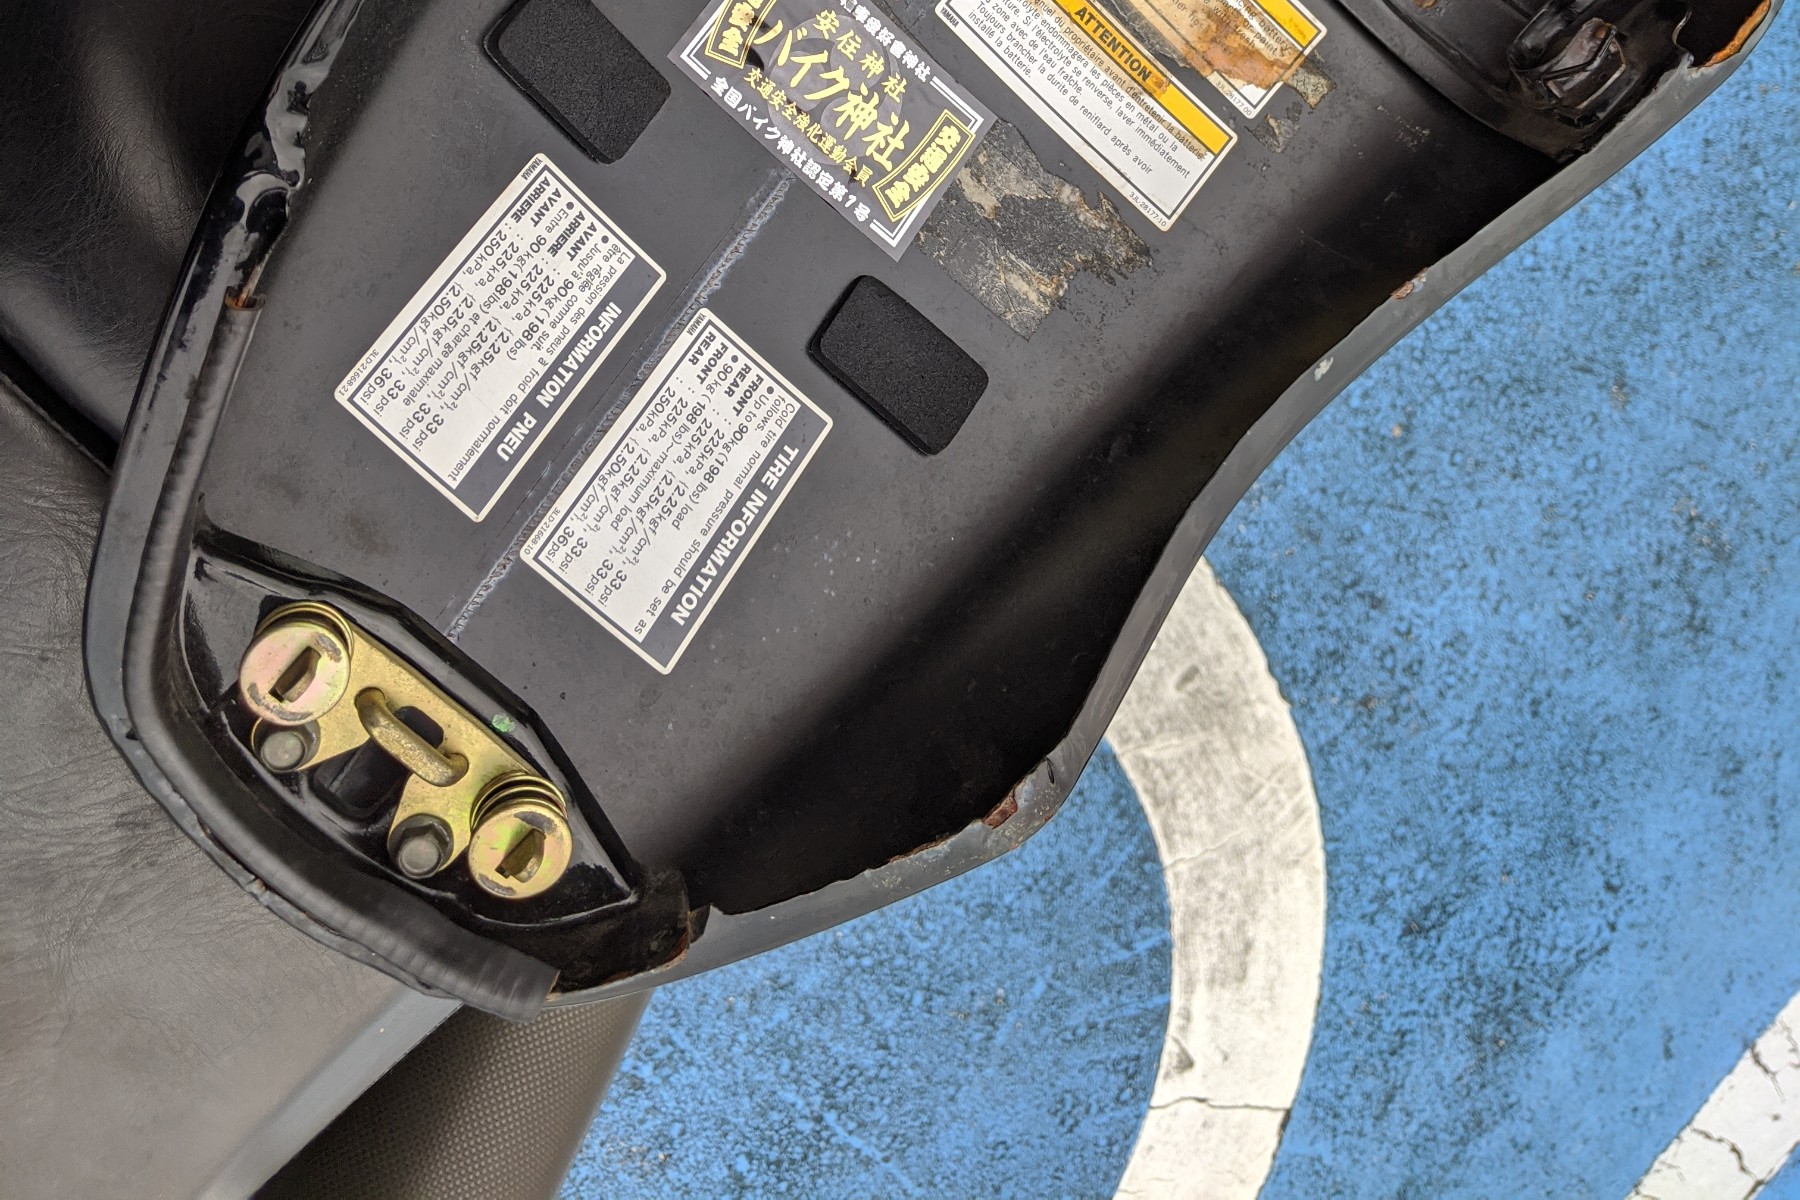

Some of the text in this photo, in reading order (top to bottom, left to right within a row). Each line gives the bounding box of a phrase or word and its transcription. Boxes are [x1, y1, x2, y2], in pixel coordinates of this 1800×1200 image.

[939, 6, 959, 27] YAMAHA
[967, 9, 1032, 77] installé la batterie.
[991, 2, 1083, 95] zone avec de l'eau fraîche.
[1054, 14, 1065, 26] du
[1063, 24, 1105, 66] propriétaire
[1104, 65, 1126, 87] avant
[1073, 5, 1152, 82] ATTENTION
[811, 7, 908, 103] 安住神社
[975, 0, 1153, 174] Toujours brancher durite de reniflard après avoir
[1040, 17, 1092, 68] endommagera
[1088, 62, 1105, 80] les
[1100, 78, 1125, 102] pièces
[1124, 101, 1135, 112] en
[1135, 110, 1159, 133] métal
[1157, 132, 1168, 143] ou
[1169, 140, 1178, 152] la
[750, 14, 913, 173] バイク神社
[1071, 66, 1082, 77] se
[1081, 76, 1113, 109] renverse,
[1114, 105, 1135, 126] laver
[1134, 125, 1190, 178] immédiatement
[510, 176, 550, 223] ARRIERE
[520, 156, 542, 180] YAMAHA
[529, 187, 562, 227] AVANT
[546, 210, 585, 257] ARRIERE
[565, 221, 597, 261] AVANT
[402, 207, 569, 406] Entre et charge maximale
[530, 243, 621, 352] être réglée comme suit.
[686, 312, 706, 336] YAMAHA
[447, 251, 630, 482] La pression des pneus à froid doit normalement
[496, 301, 622, 461] INFORMATION PNEU
[688, 331, 716, 365] REAR
[695, 341, 728, 384] FRONT
[723, 362, 752, 397] REAR
[731, 373, 764, 416] FRONT
[754, 394, 785, 432] follows.
[671, 393, 769, 530] Up to load
[609, 504, 632, 531] load
[634, 402, 795, 634] Cold tire normal pressure should be set as
[670, 443, 799, 625] TIRE INFORMATION
